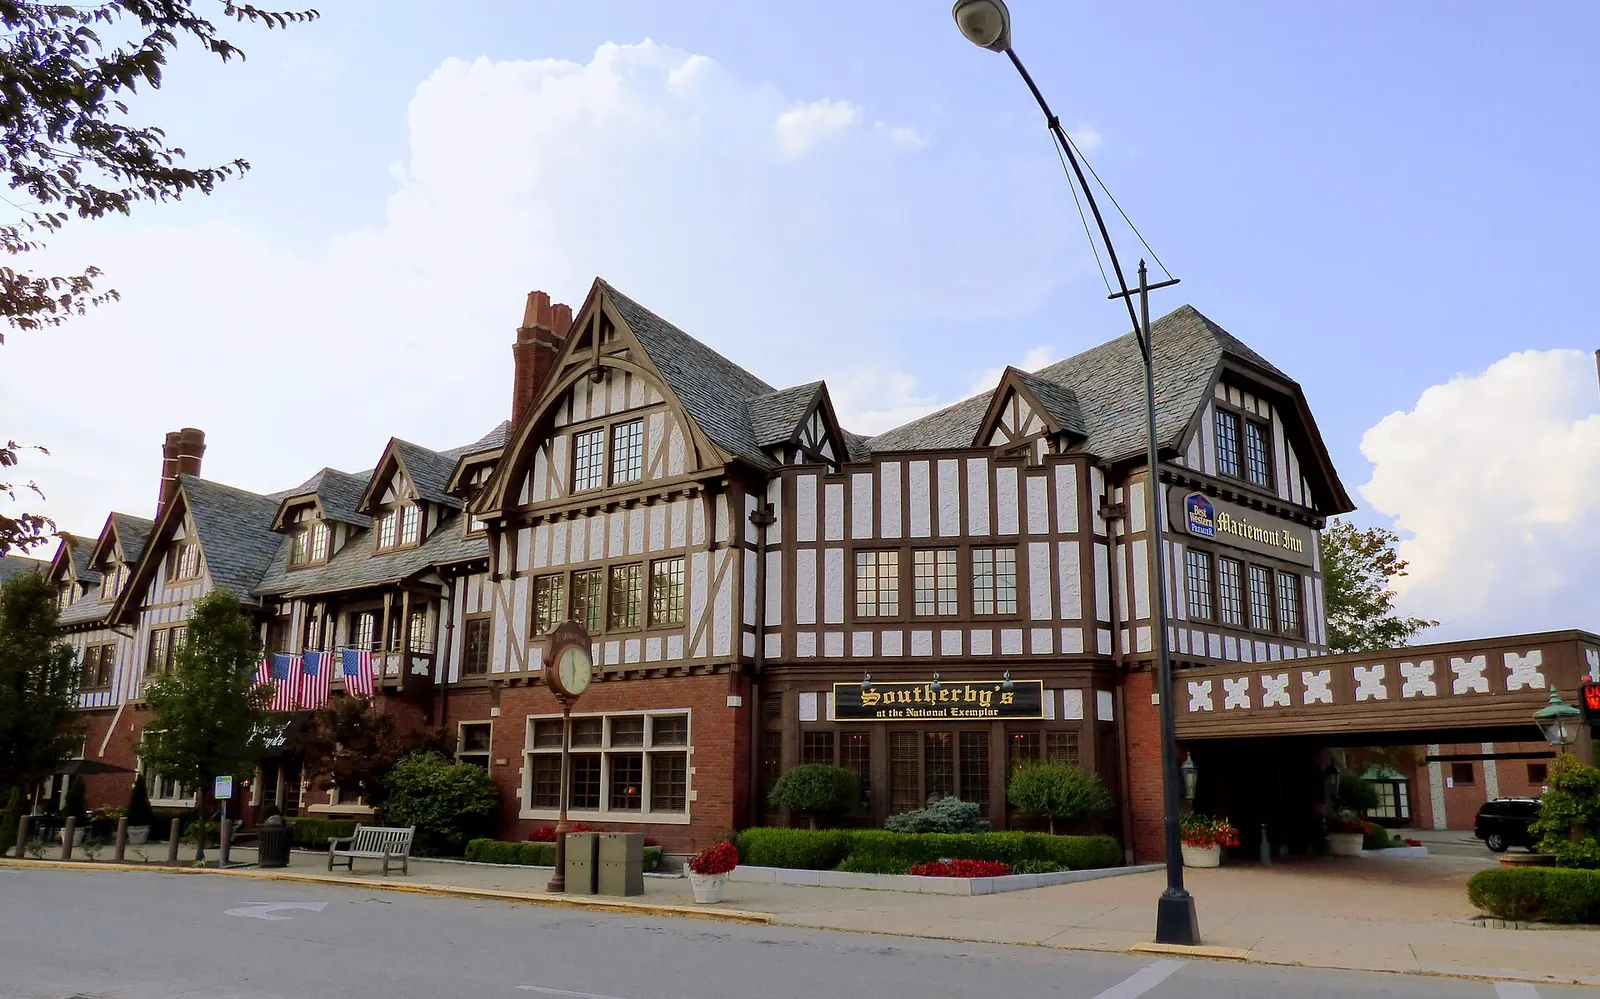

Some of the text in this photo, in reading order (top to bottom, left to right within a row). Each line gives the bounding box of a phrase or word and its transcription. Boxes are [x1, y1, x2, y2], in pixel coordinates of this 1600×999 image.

[1189, 511, 1213, 528] Western
[1193, 504, 1207, 518] Best
[1217, 511, 1303, 553] Mariemont Inn
[860, 684, 1014, 708] Southerby's
[876, 707, 999, 718] at the National Exemplar
